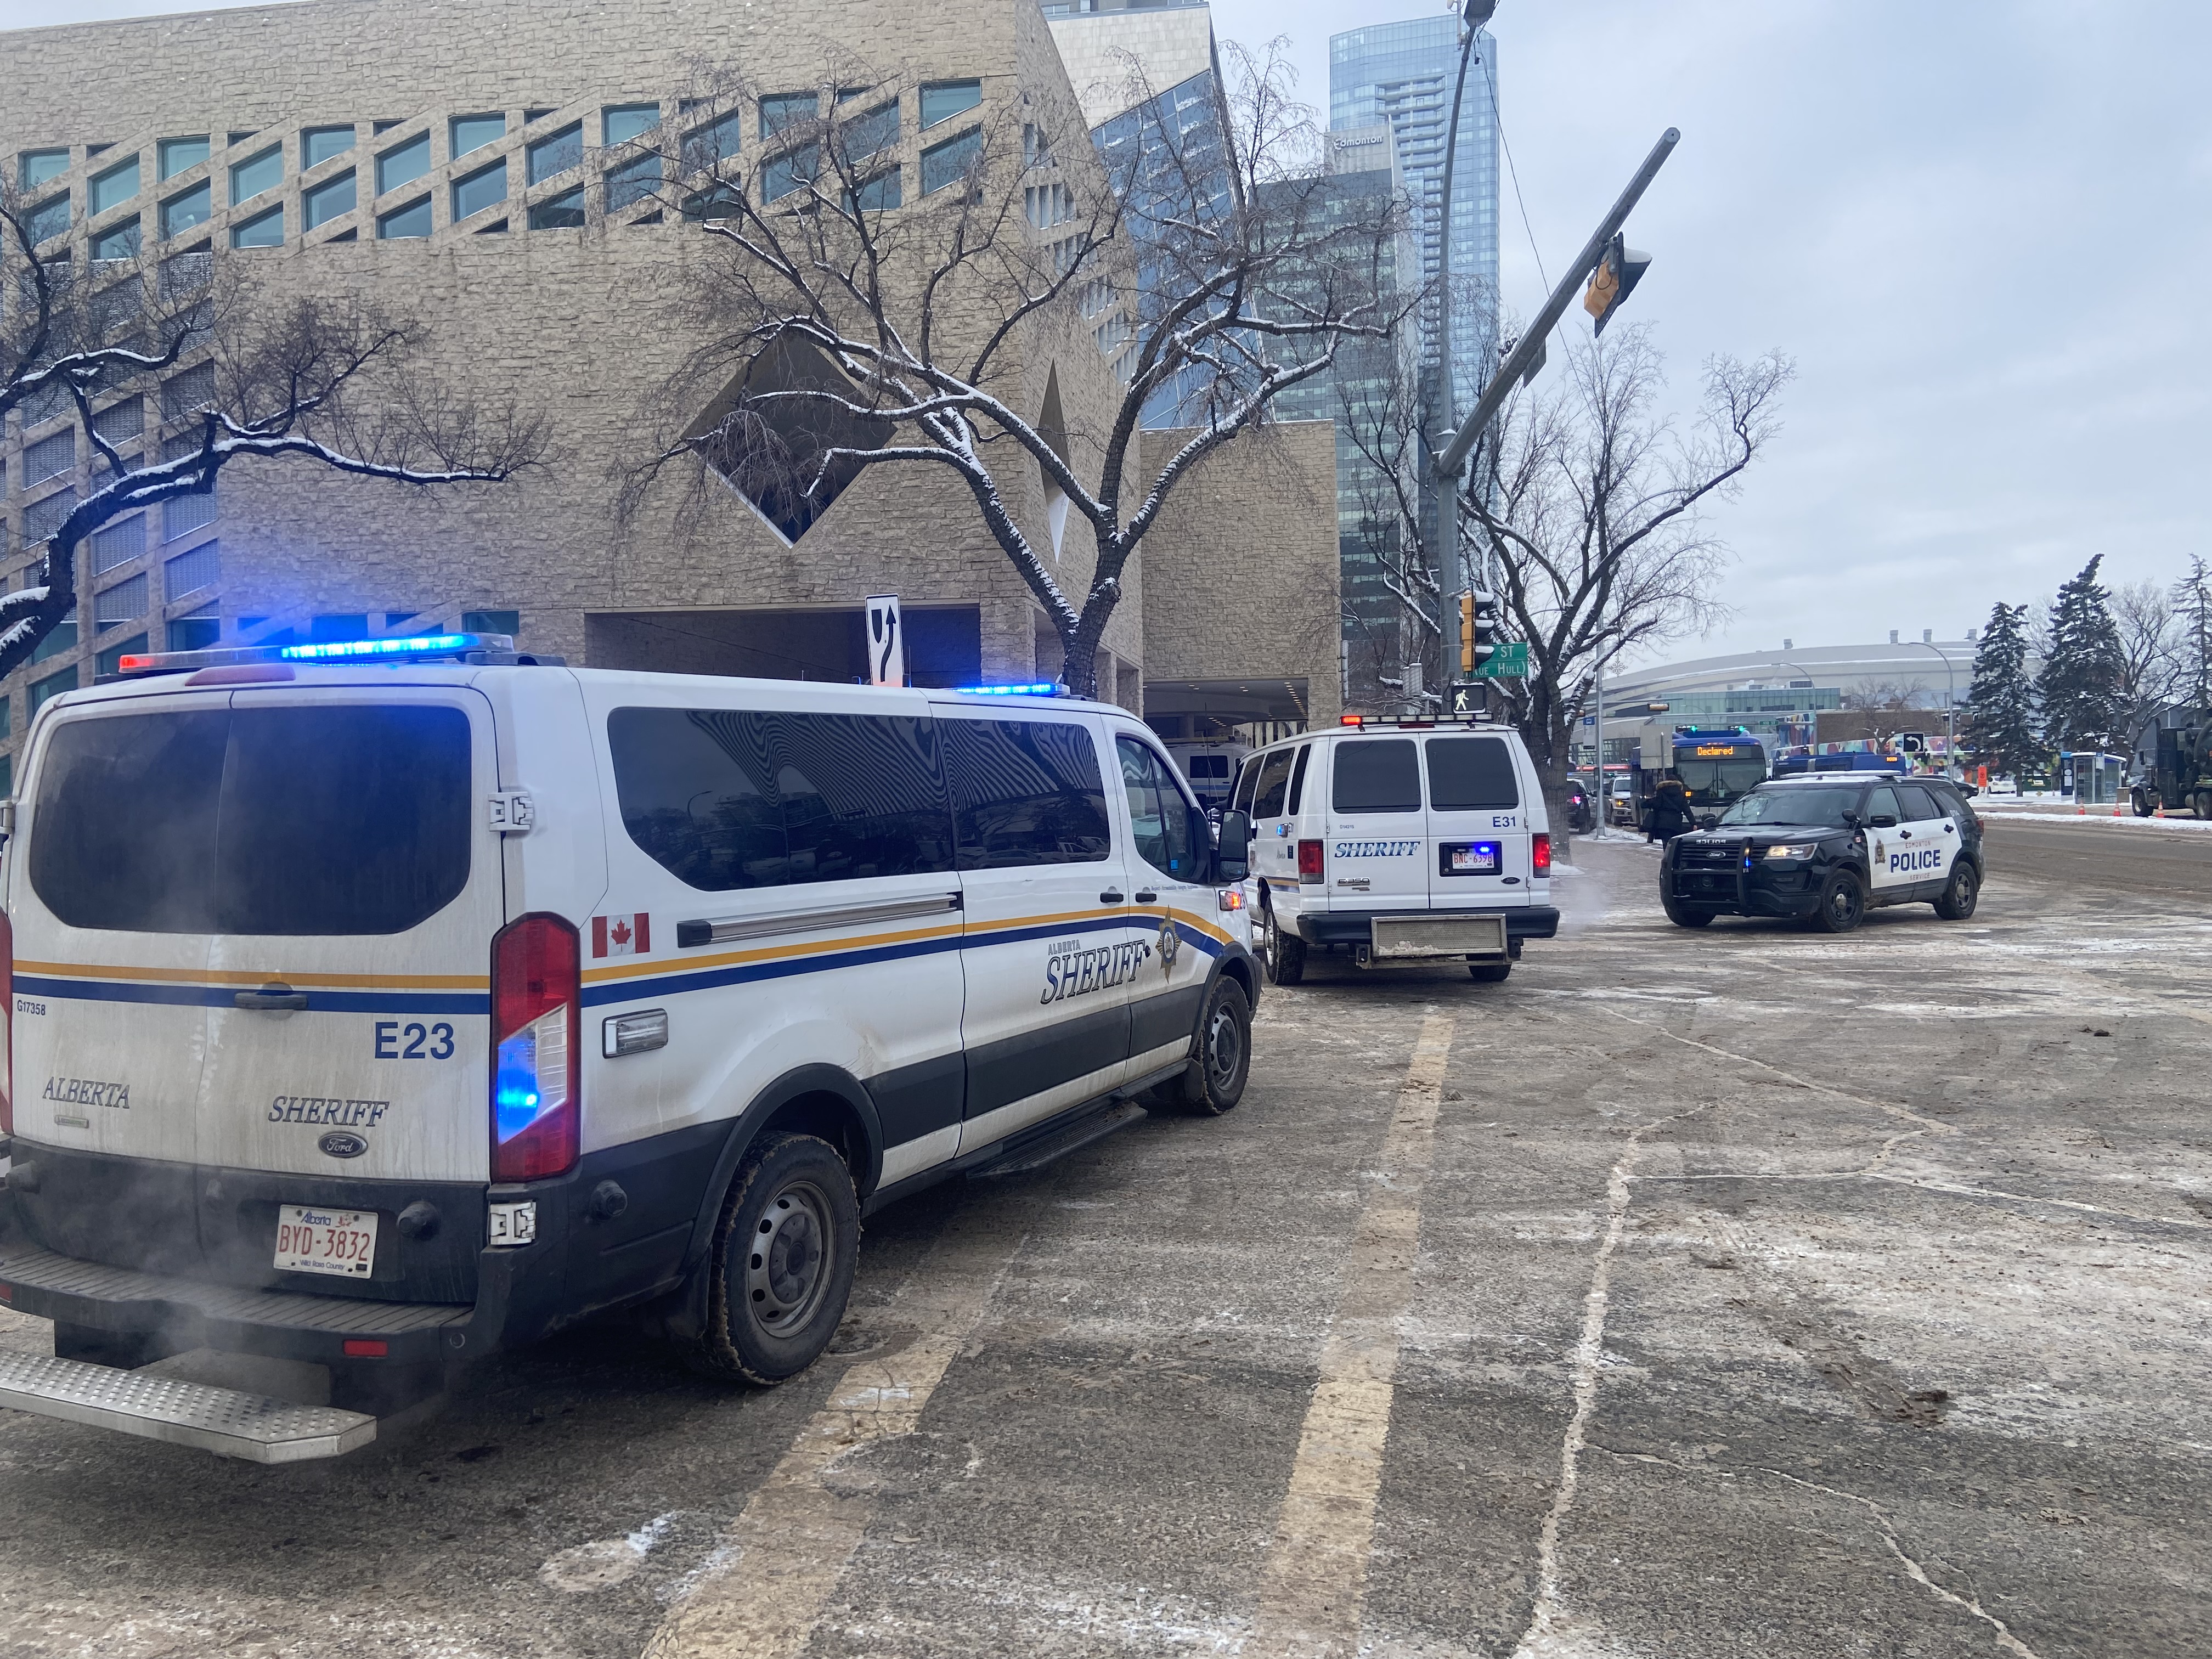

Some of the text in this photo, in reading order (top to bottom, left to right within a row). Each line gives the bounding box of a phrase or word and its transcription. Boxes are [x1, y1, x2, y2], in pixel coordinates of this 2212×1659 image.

[1334, 136, 1382, 150] Edmonton
[1500, 646, 1514, 658] ST
[1697, 746, 1733, 755] Declared
[1492, 816, 1516, 827] E31
[1334, 841, 1421, 858] SHERIFF
[1905, 840, 1931, 849] EDMONTON
[1891, 849, 1941, 873] POLICE
[1048, 939, 1081, 956] ALBERTA
[1040, 939, 1146, 1005] SHERIFF
[17, 1000, 46, 1016] G17358
[375, 1022, 455, 1060] E23
[42, 1076, 130, 1109] ALBERTA
[268, 1096, 390, 1127] SHERIFF
[326, 1137, 353, 1153] Ford
[301, 1210, 331, 1226] Alberta
[279, 1224, 370, 1262] BYD-3832
[326, 1262, 346, 1270] County
